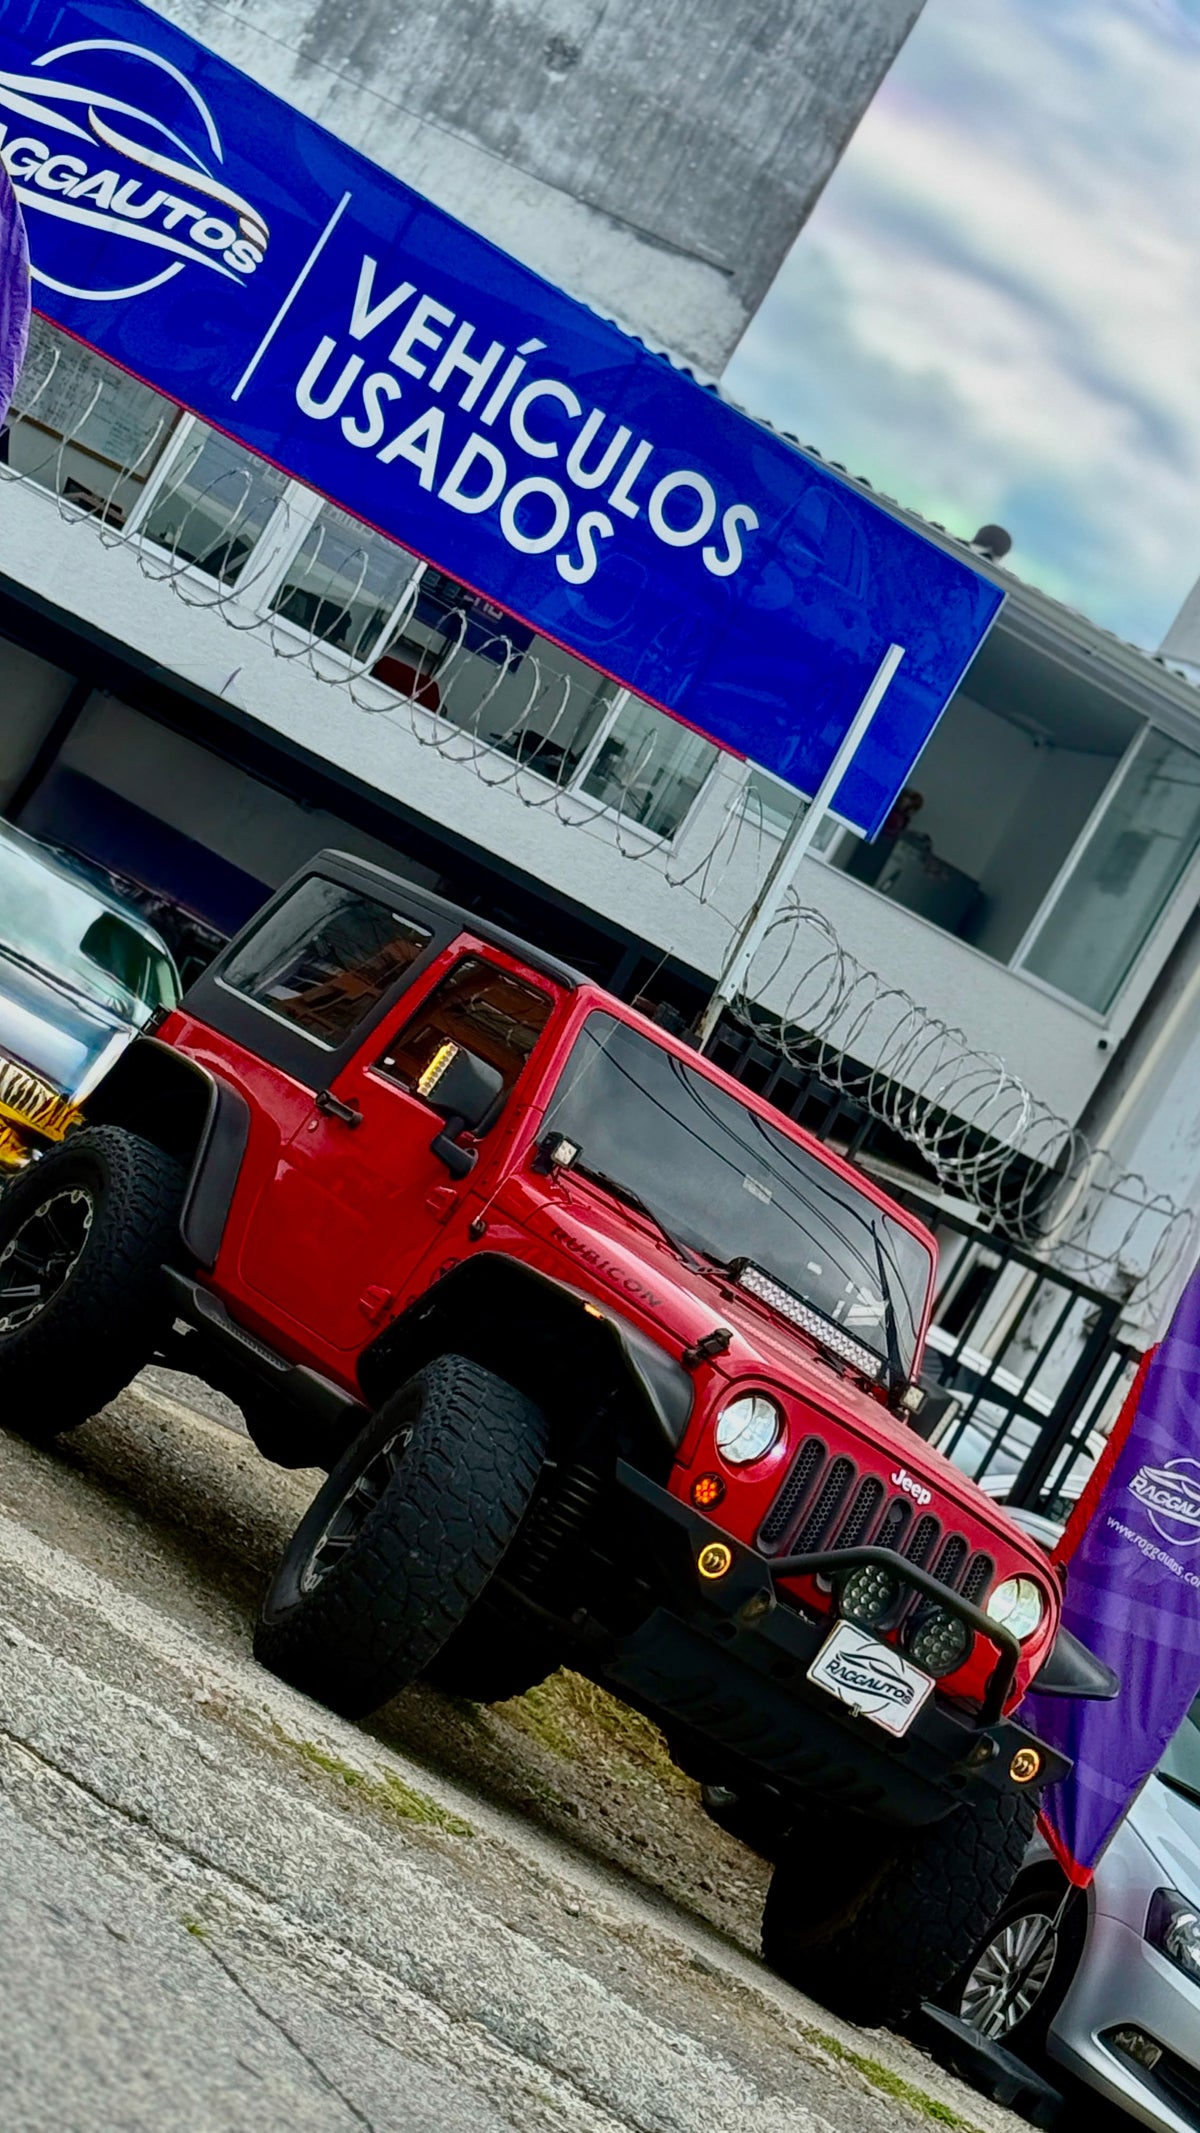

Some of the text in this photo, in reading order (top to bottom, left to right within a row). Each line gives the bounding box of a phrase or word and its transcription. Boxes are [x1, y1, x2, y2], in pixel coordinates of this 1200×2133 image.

[0, 121, 264, 274] GGAUTOS
[294, 334, 615, 585] USADOS
[348, 254, 760, 577] VEHÍCULOS
[552, 1227, 663, 1308] RUBICON
[891, 1469, 932, 1505] Jeep
[825, 1658, 912, 1705] RAGGAUTOS
